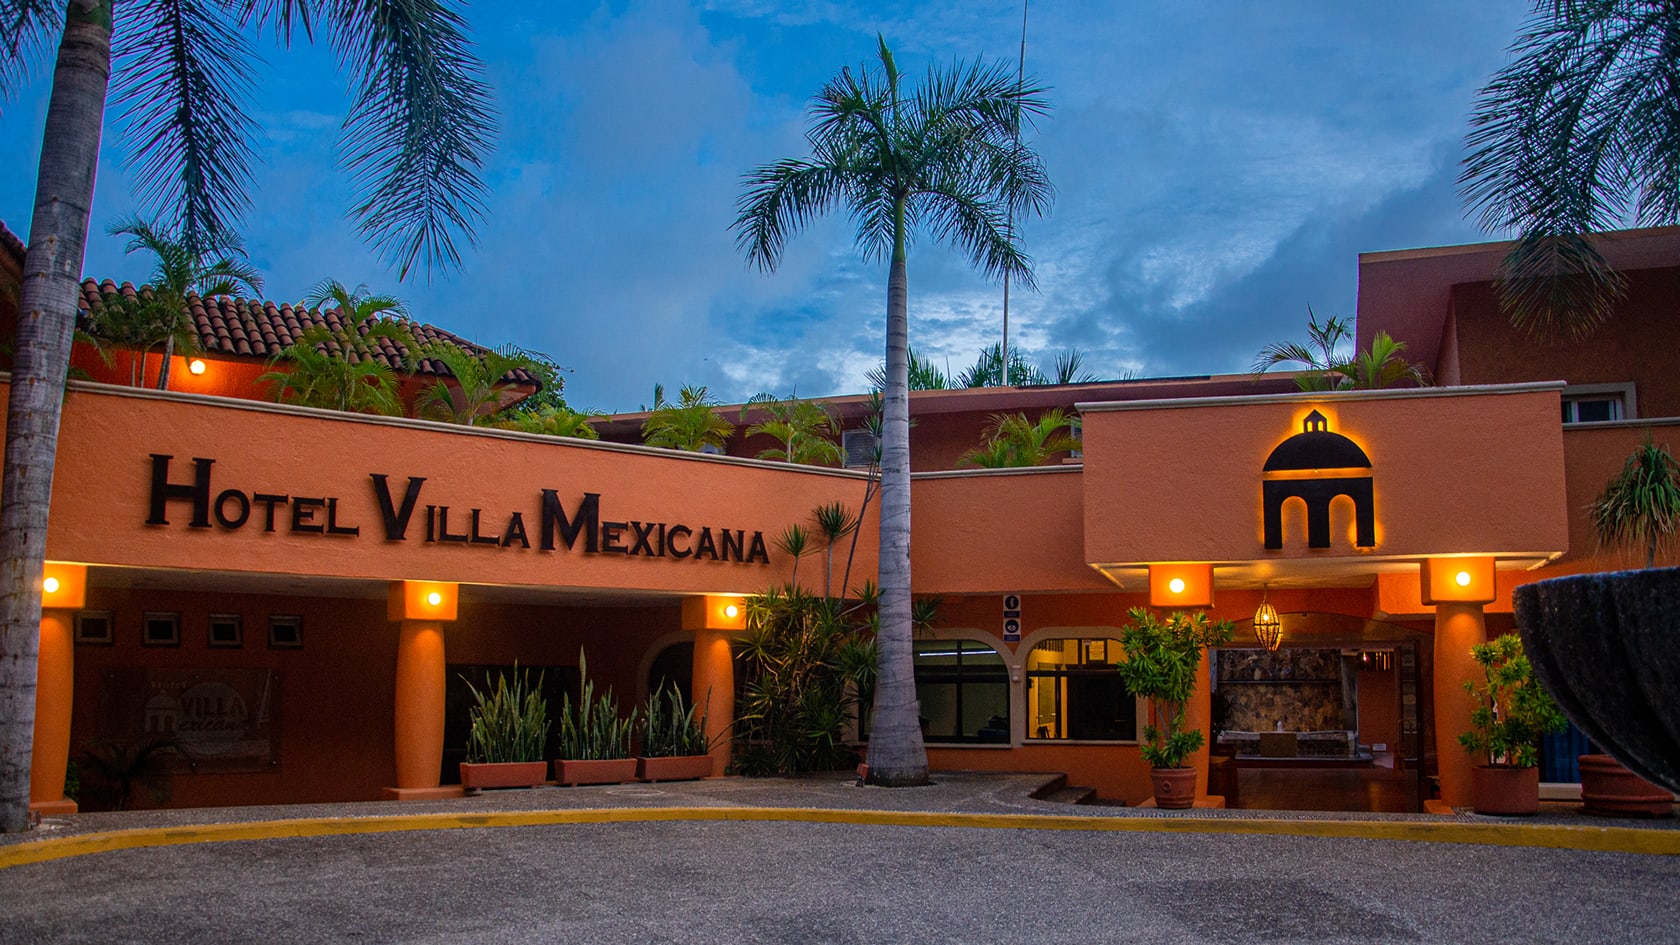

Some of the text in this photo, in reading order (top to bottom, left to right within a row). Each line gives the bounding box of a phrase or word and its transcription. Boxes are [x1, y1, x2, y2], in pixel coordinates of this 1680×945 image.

[145, 453, 770, 565] HOTEL VILLA MEXICANA
[180, 696, 245, 718] VILLA
